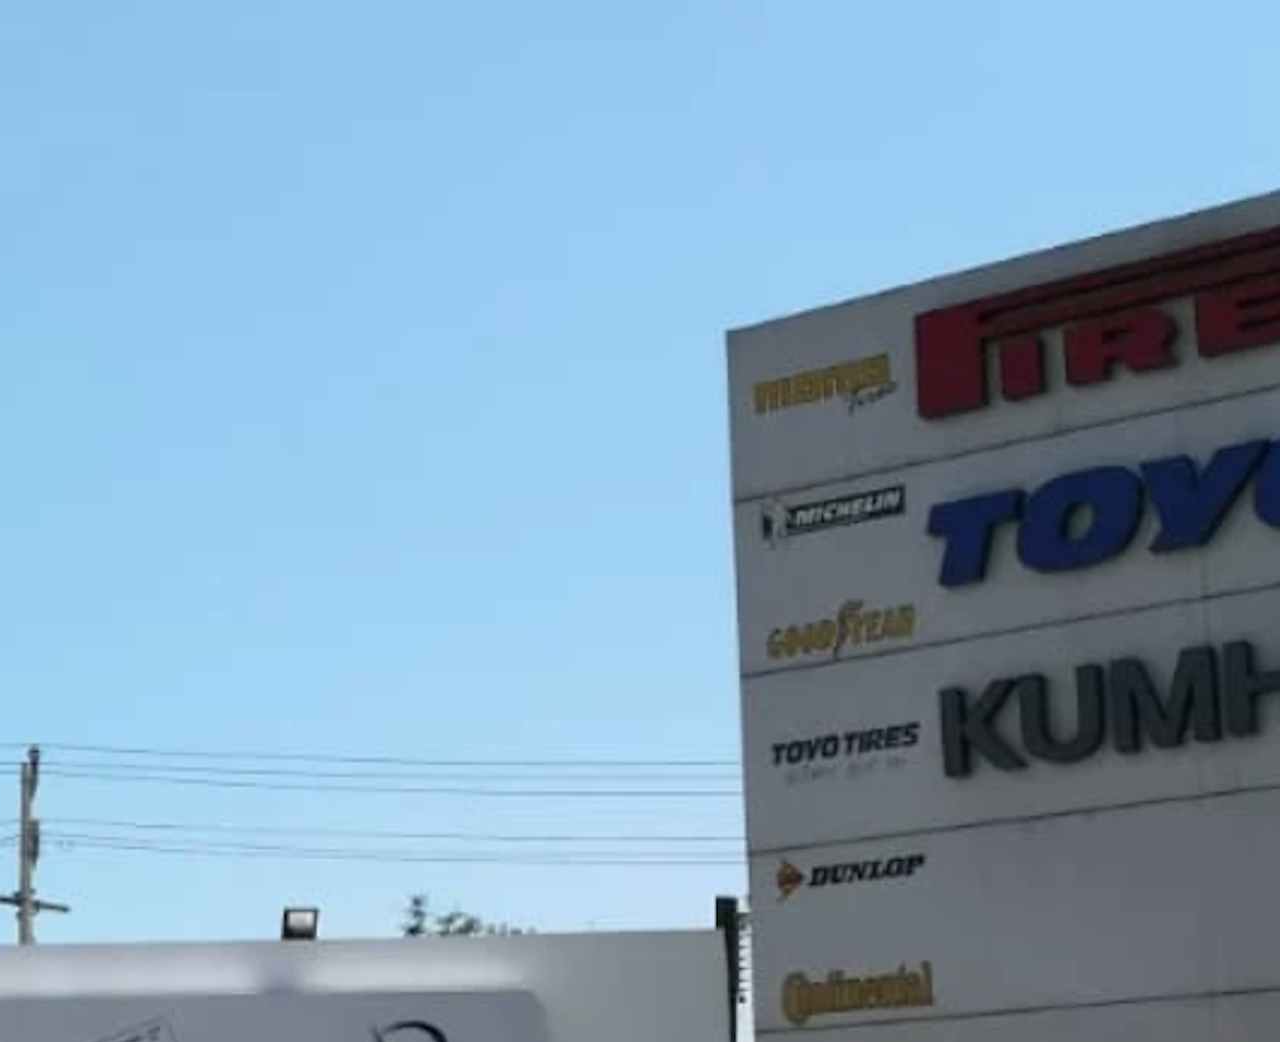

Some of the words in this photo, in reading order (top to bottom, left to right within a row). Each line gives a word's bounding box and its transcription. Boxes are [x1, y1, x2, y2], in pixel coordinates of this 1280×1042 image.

[794, 489, 902, 527] MICHELIN
[926, 438, 1280, 588] TOY
[772, 733, 840, 766] TOYO
[843, 720, 921, 755] TIRES
[807, 854, 926, 887] DUNLOP
